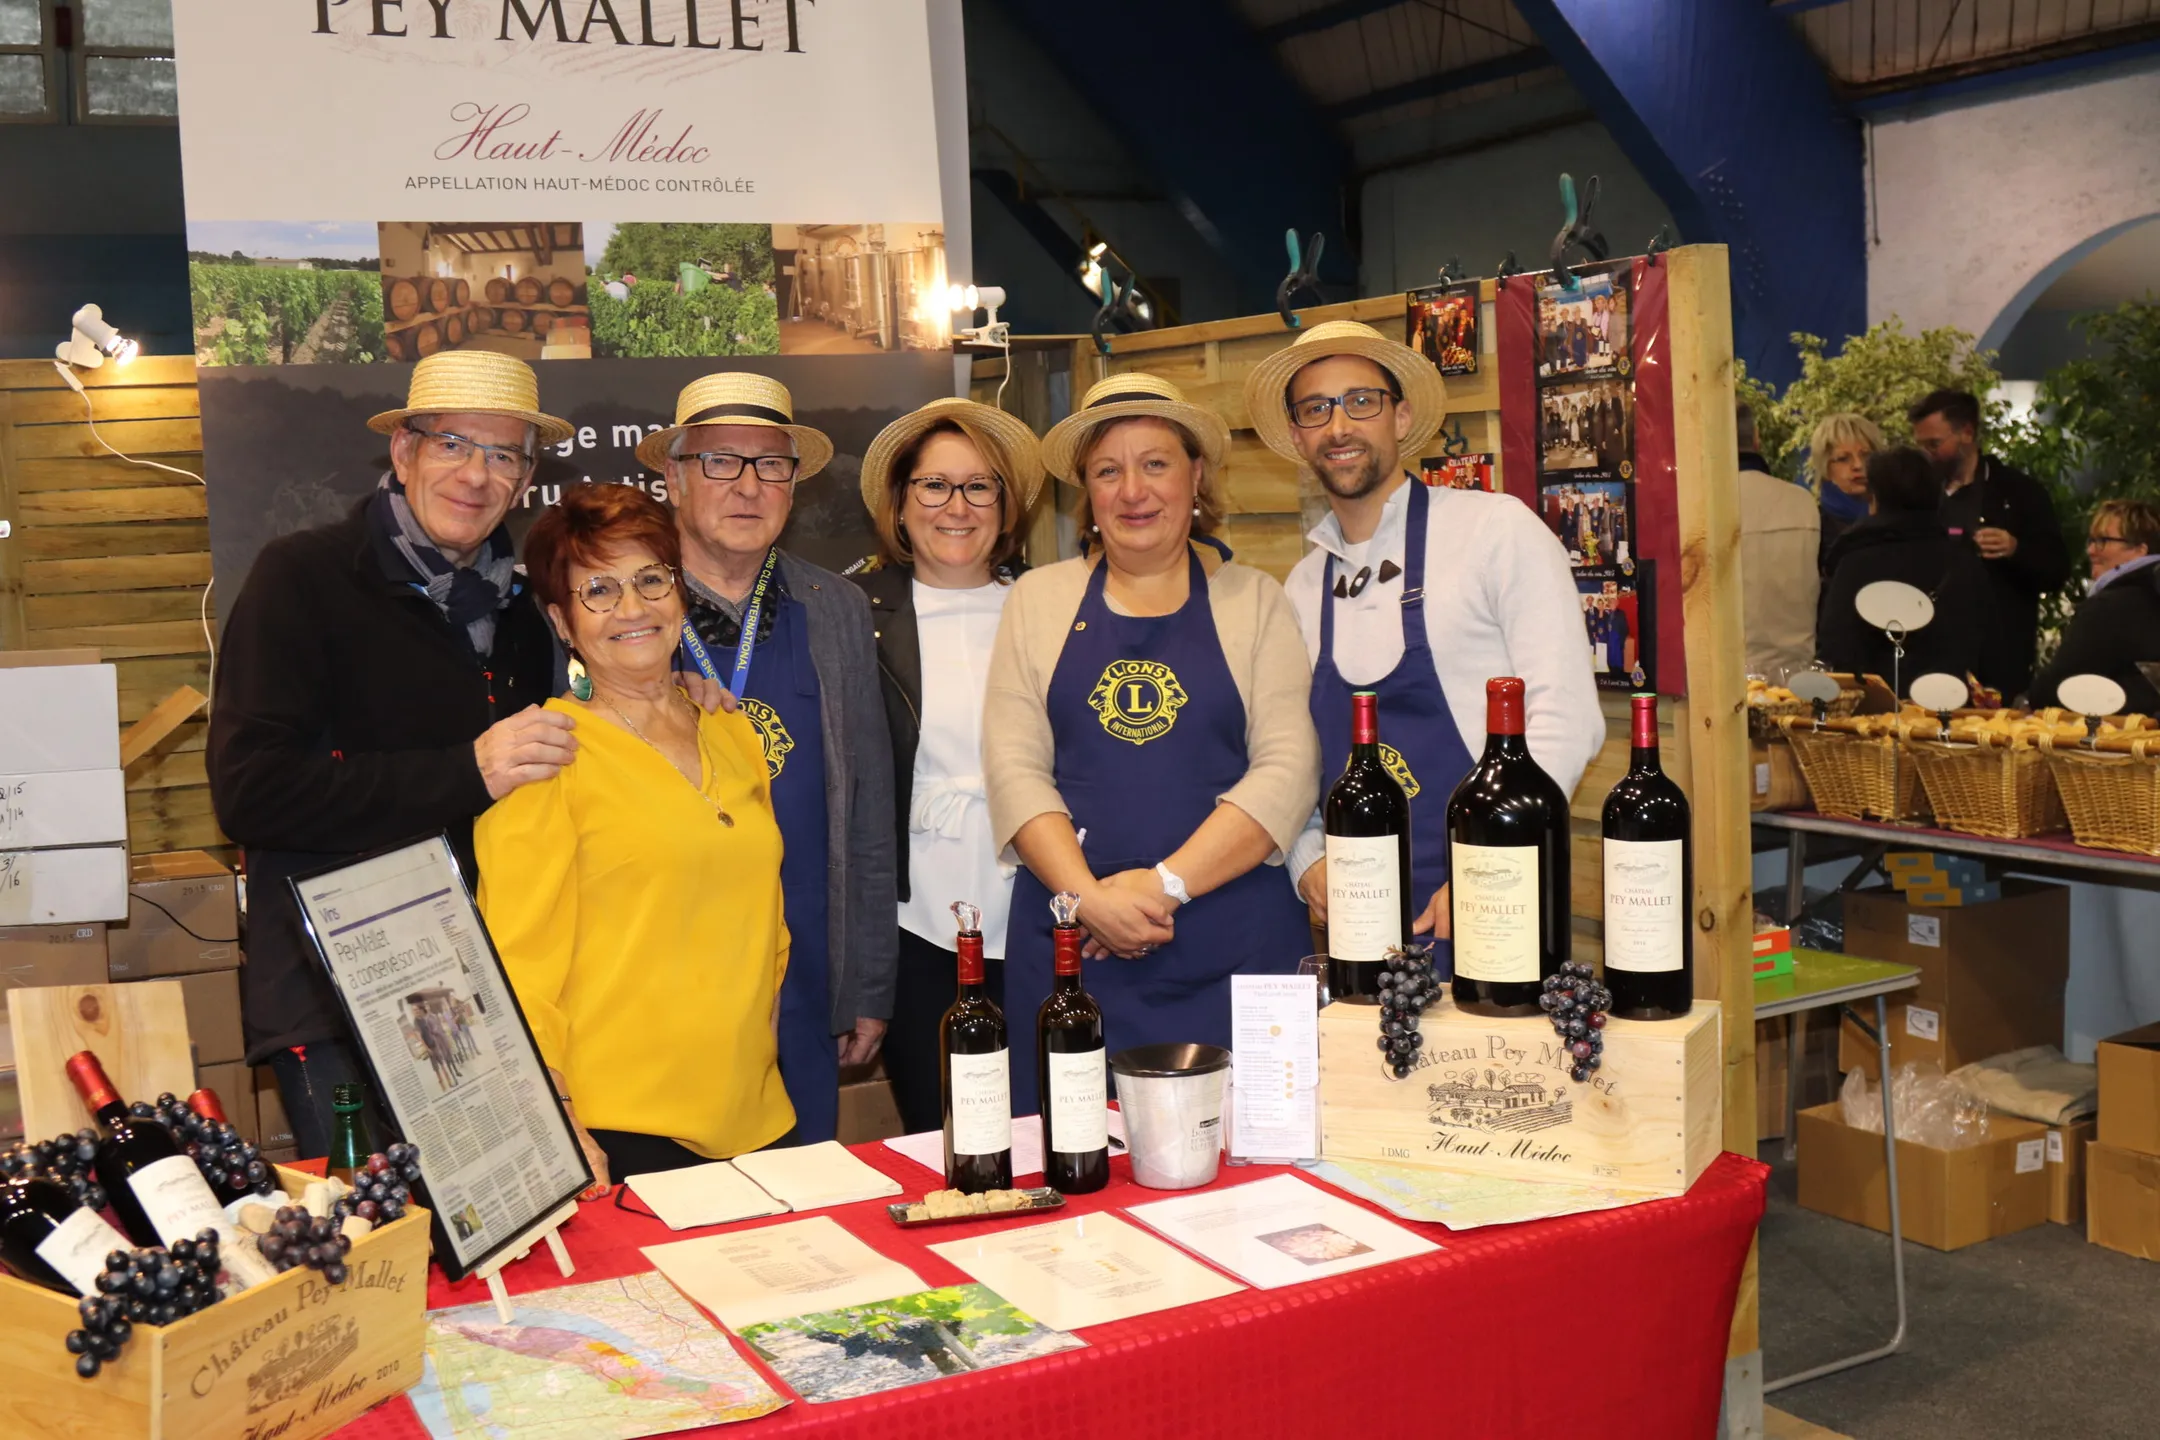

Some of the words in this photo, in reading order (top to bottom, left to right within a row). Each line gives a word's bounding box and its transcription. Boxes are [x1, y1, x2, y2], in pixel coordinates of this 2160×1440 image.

[311, 0, 456, 39] PEY
[495, 0, 815, 53] MALLET
[404, 175, 528, 191] APPELLATION
[532, 174, 651, 193] HAUT-MÉDOC
[655, 175, 756, 194] CONTRÔLÉE
[754, 568, 772, 597] CLUBS
[683, 625, 705, 659] CLUBS
[736, 595, 761, 672] INTERNATIONAL
[1111, 663, 1165, 678] LIONS
[1127, 684, 1153, 713] L
[1110, 720, 1168, 738] INTERNATIONAL
[1332, 888, 1347, 899] PEY
[1349, 888, 1392, 900] MALLET
[1610, 893, 1627, 905] PEY
[1628, 895, 1673, 907] MALLET
[317, 905, 341, 924] Vins
[1460, 900, 1477, 913] PEY
[1479, 904, 1527, 915] MALLET
[1485, 1035, 1527, 1066] Pey
[960, 1096, 976, 1106] PEY
[1060, 1095, 1075, 1104] PEY
[1387, 1146, 1411, 1159] DMG
[190, 1307, 289, 1399] Château
[295, 1279, 332, 1312] Pey
[339, 1260, 408, 1293] Mallet
[375, 1360, 401, 1380] 2010
